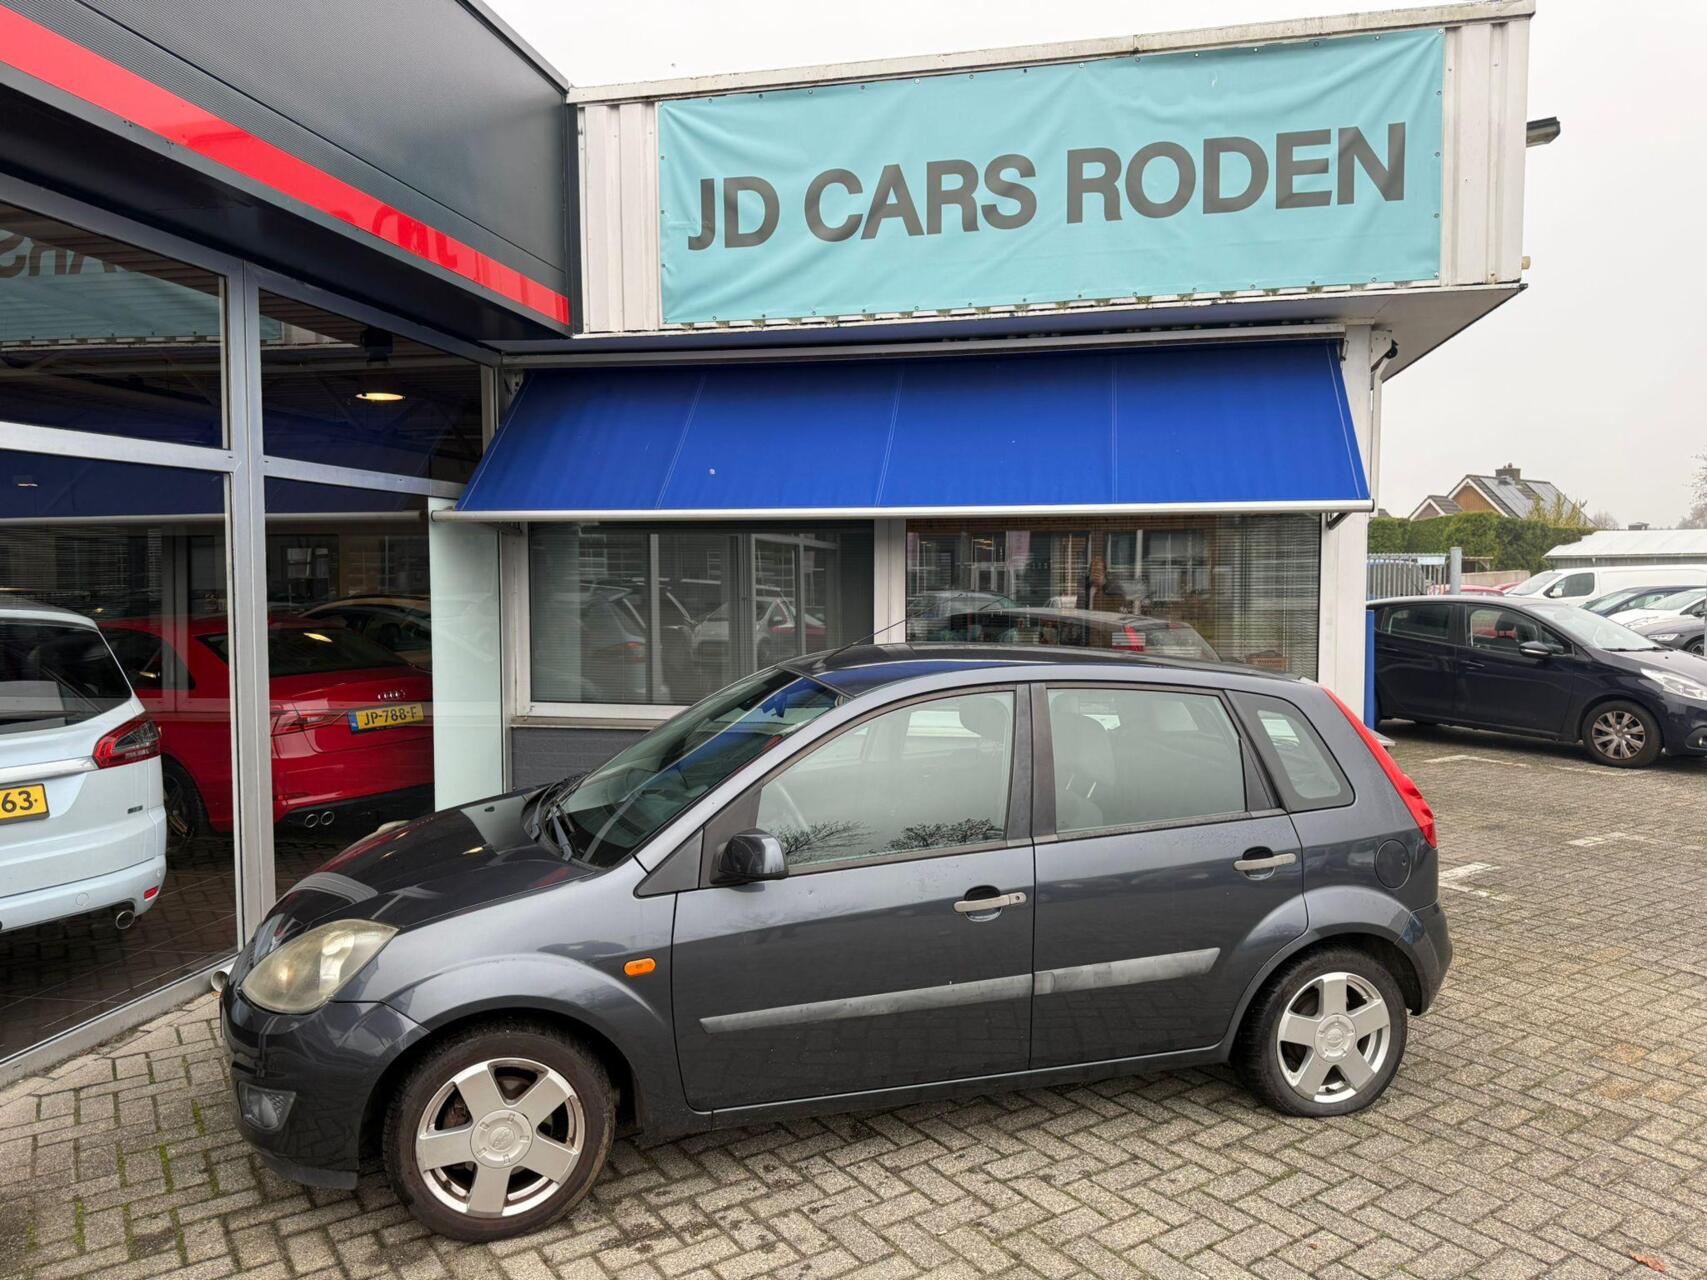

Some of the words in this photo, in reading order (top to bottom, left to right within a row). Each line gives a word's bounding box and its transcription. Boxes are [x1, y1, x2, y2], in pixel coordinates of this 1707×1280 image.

[688, 177, 780, 251] JD
[805, 154, 1037, 243] CARS
[1067, 123, 1406, 225] RODEN
[364, 706, 417, 726] JP-788-F
